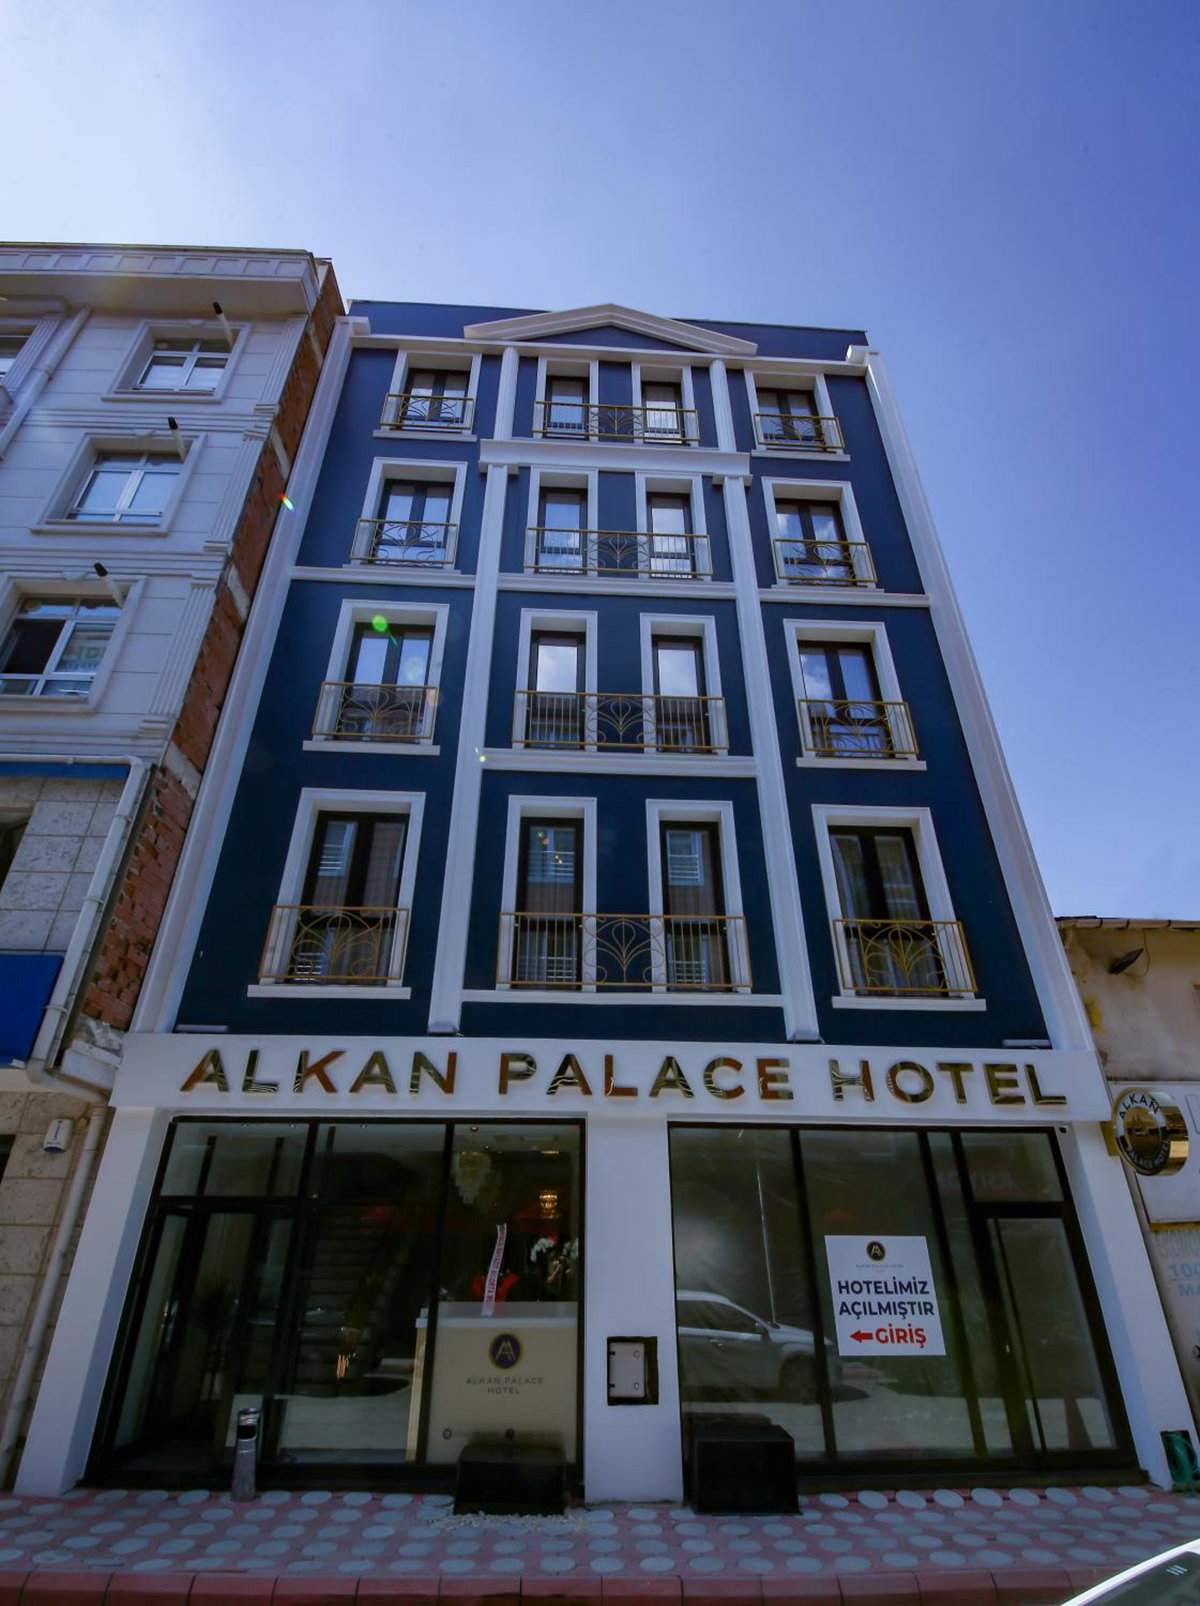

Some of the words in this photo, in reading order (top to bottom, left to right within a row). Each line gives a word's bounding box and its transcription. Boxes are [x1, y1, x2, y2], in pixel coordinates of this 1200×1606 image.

[180, 1049, 458, 1094] ALKAN
[498, 1052, 794, 1100] PALACE
[828, 1059, 1067, 1106] HOTEL
[1119, 1093, 1160, 1120] ALKAN
[838, 1276, 930, 1295] HOTELİMİZ
[1177, 1283, 1200, 1296] M
[839, 1301, 935, 1320] AÇILMIŞTIR
[875, 1323, 927, 1349] GİRİŞ
[504, 1376, 544, 1385] PALACE
[487, 1387, 520, 1395] HOTEL
